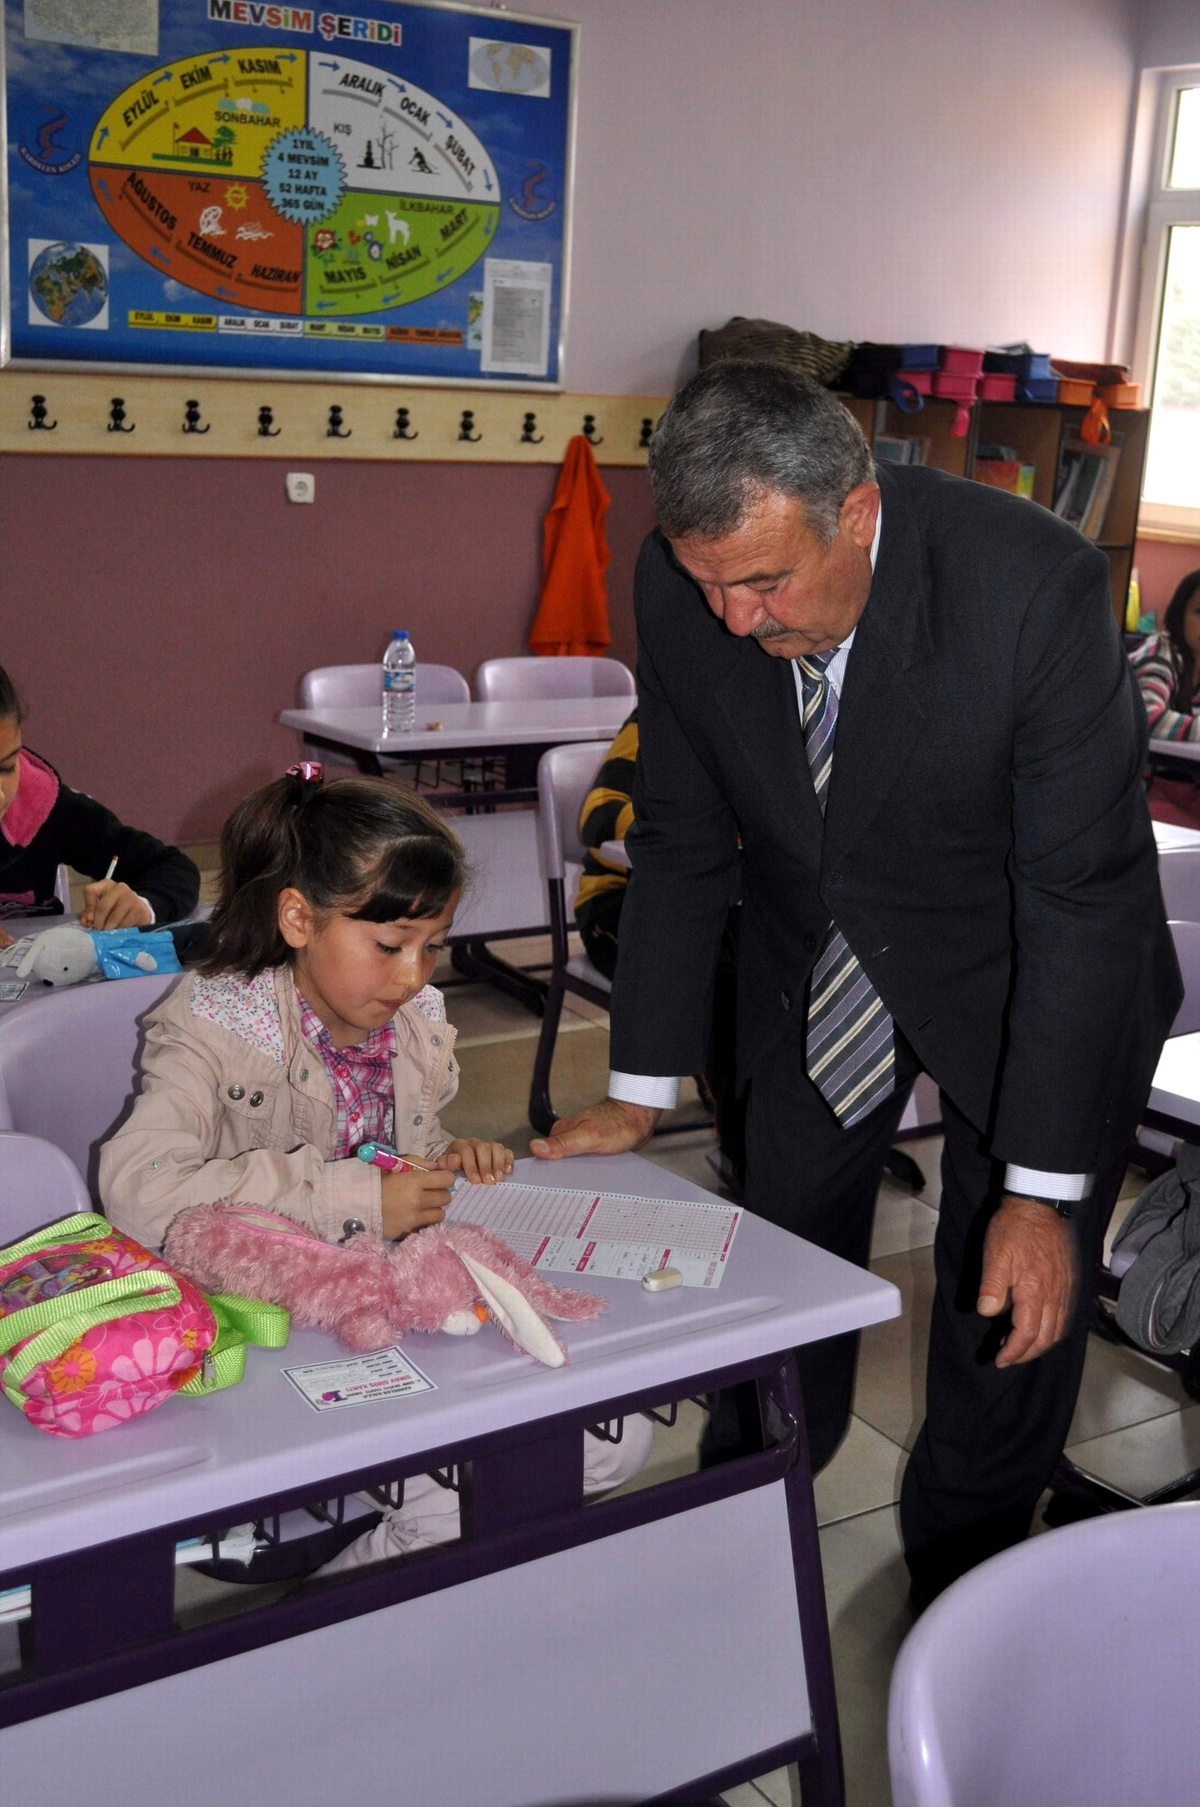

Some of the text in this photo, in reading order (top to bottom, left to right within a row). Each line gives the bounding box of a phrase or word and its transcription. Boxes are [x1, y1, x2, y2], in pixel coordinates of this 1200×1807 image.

[180, 65, 213, 90] EKİM
[238, 58, 282, 75] KASIM
[339, 73, 386, 98] ARALIK
[122, 90, 159, 127] EYLÜL
[215, 111, 281, 127] SONBAHAR
[400, 97, 431, 126] OCAK
[278, 152, 329, 167] 4 MEVSİM
[446, 134, 477, 177] ŞUBAT
[288, 169, 318, 180] 12 AY
[188, 181, 210, 194] YAZ
[279, 183, 327, 196] 52 HAFTA
[126, 172, 177, 230] AĞUSTOS
[440, 208, 469, 240] MART
[187, 232, 238, 269] TEMMUZ
[385, 245, 422, 271] NİSAN
[251, 263, 301, 283] HAZİRAN
[324, 267, 367, 285] MAYIS
